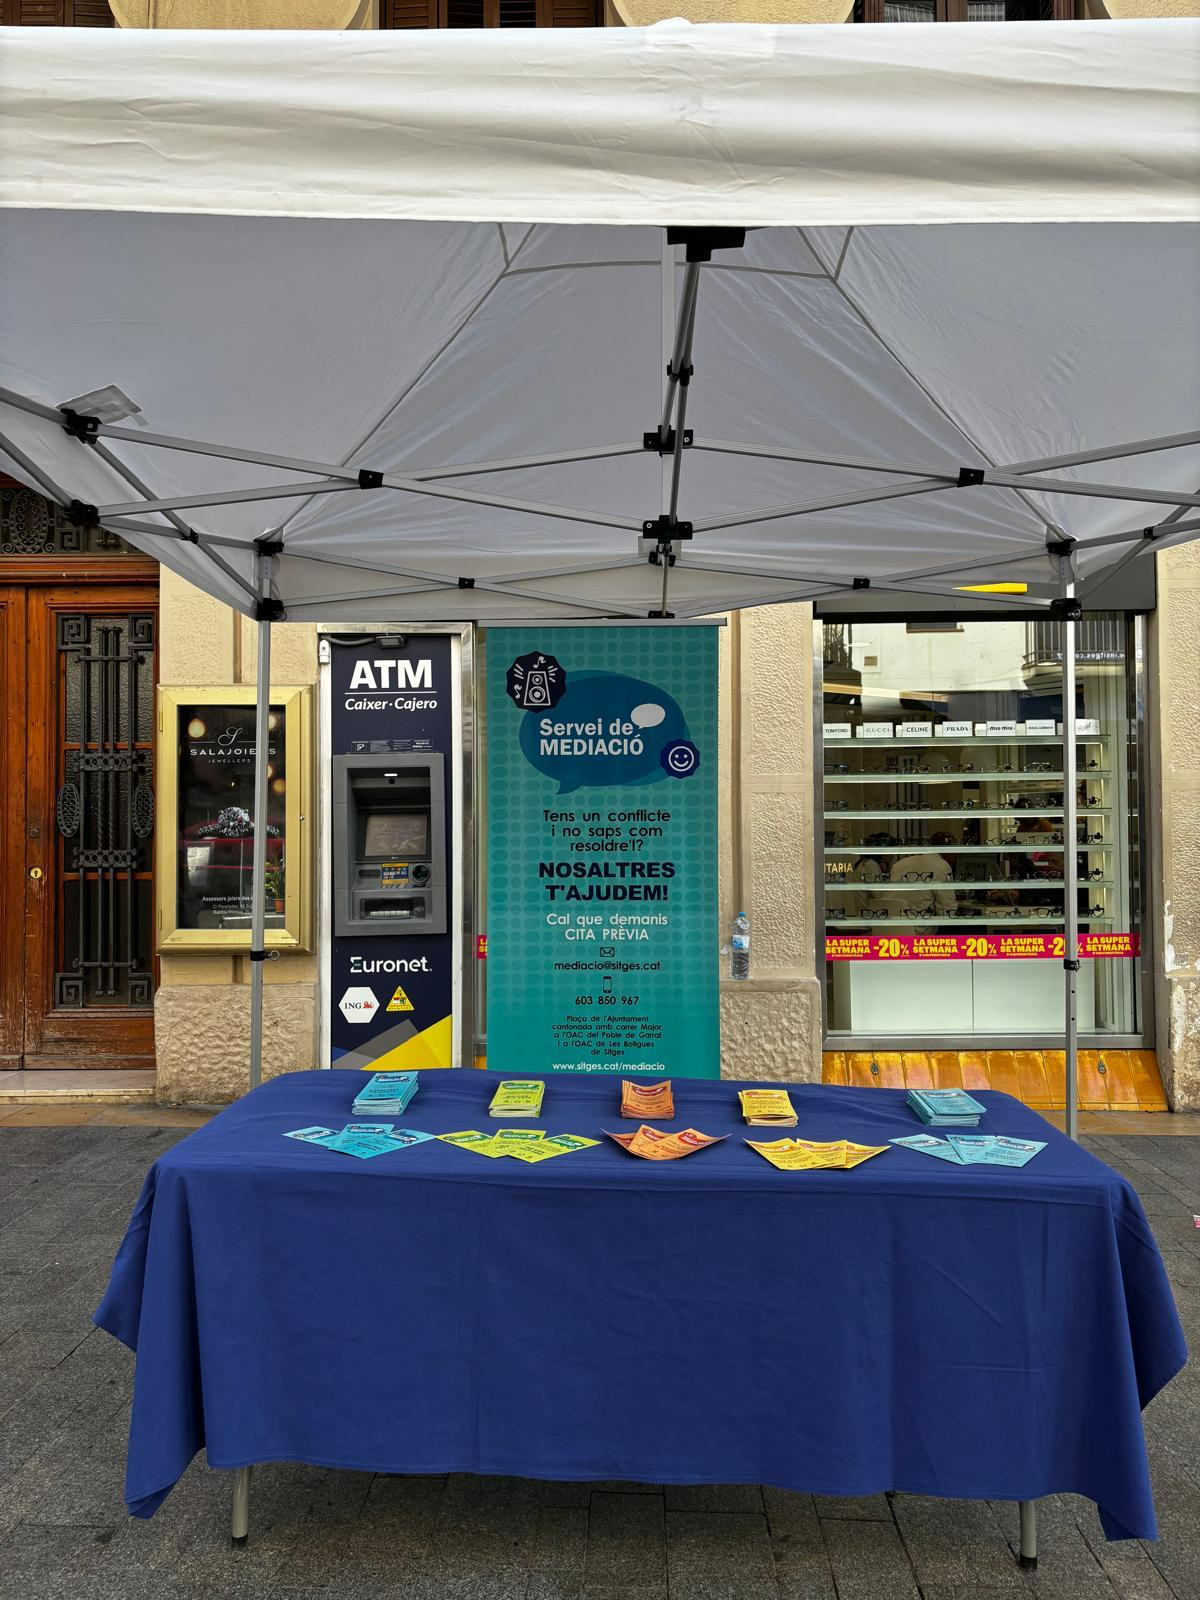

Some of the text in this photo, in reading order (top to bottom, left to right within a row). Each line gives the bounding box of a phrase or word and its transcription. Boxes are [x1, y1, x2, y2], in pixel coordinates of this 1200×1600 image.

[349, 659, 433, 689] ATM
[539, 718, 634, 736] Servei de
[540, 734, 644, 756] MEDIACIÓ
[190, 748, 276, 756] SALAJOIES
[543, 810, 671, 822] Tens un conflicte
[552, 824, 663, 840] i no saps com
[538, 862, 676, 878] NOSALTRES
[545, 885, 669, 901] T'AJUDEM!
[546, 914, 668, 928] Cal que demanis
[565, 926, 650, 940] CITA PRÈVIA
[914, 938, 957, 946] LA SUPER
[826, 946, 871, 954] SETMANA
[912, 946, 958, 954] SETMANA
[1000, 945, 1046, 953] SETMANA
[1086, 944, 1132, 952] SETMANA
[350, 956, 429, 973] Euronet
[554, 961, 661, 972] mediacio@sitges.cat
[344, 1002, 362, 1010] ING
[575, 996, 640, 1005] 603 850 967
[566, 1015, 588, 1023] Plaça
[552, 1062, 666, 1072] www.sitges.cat/mediacio
